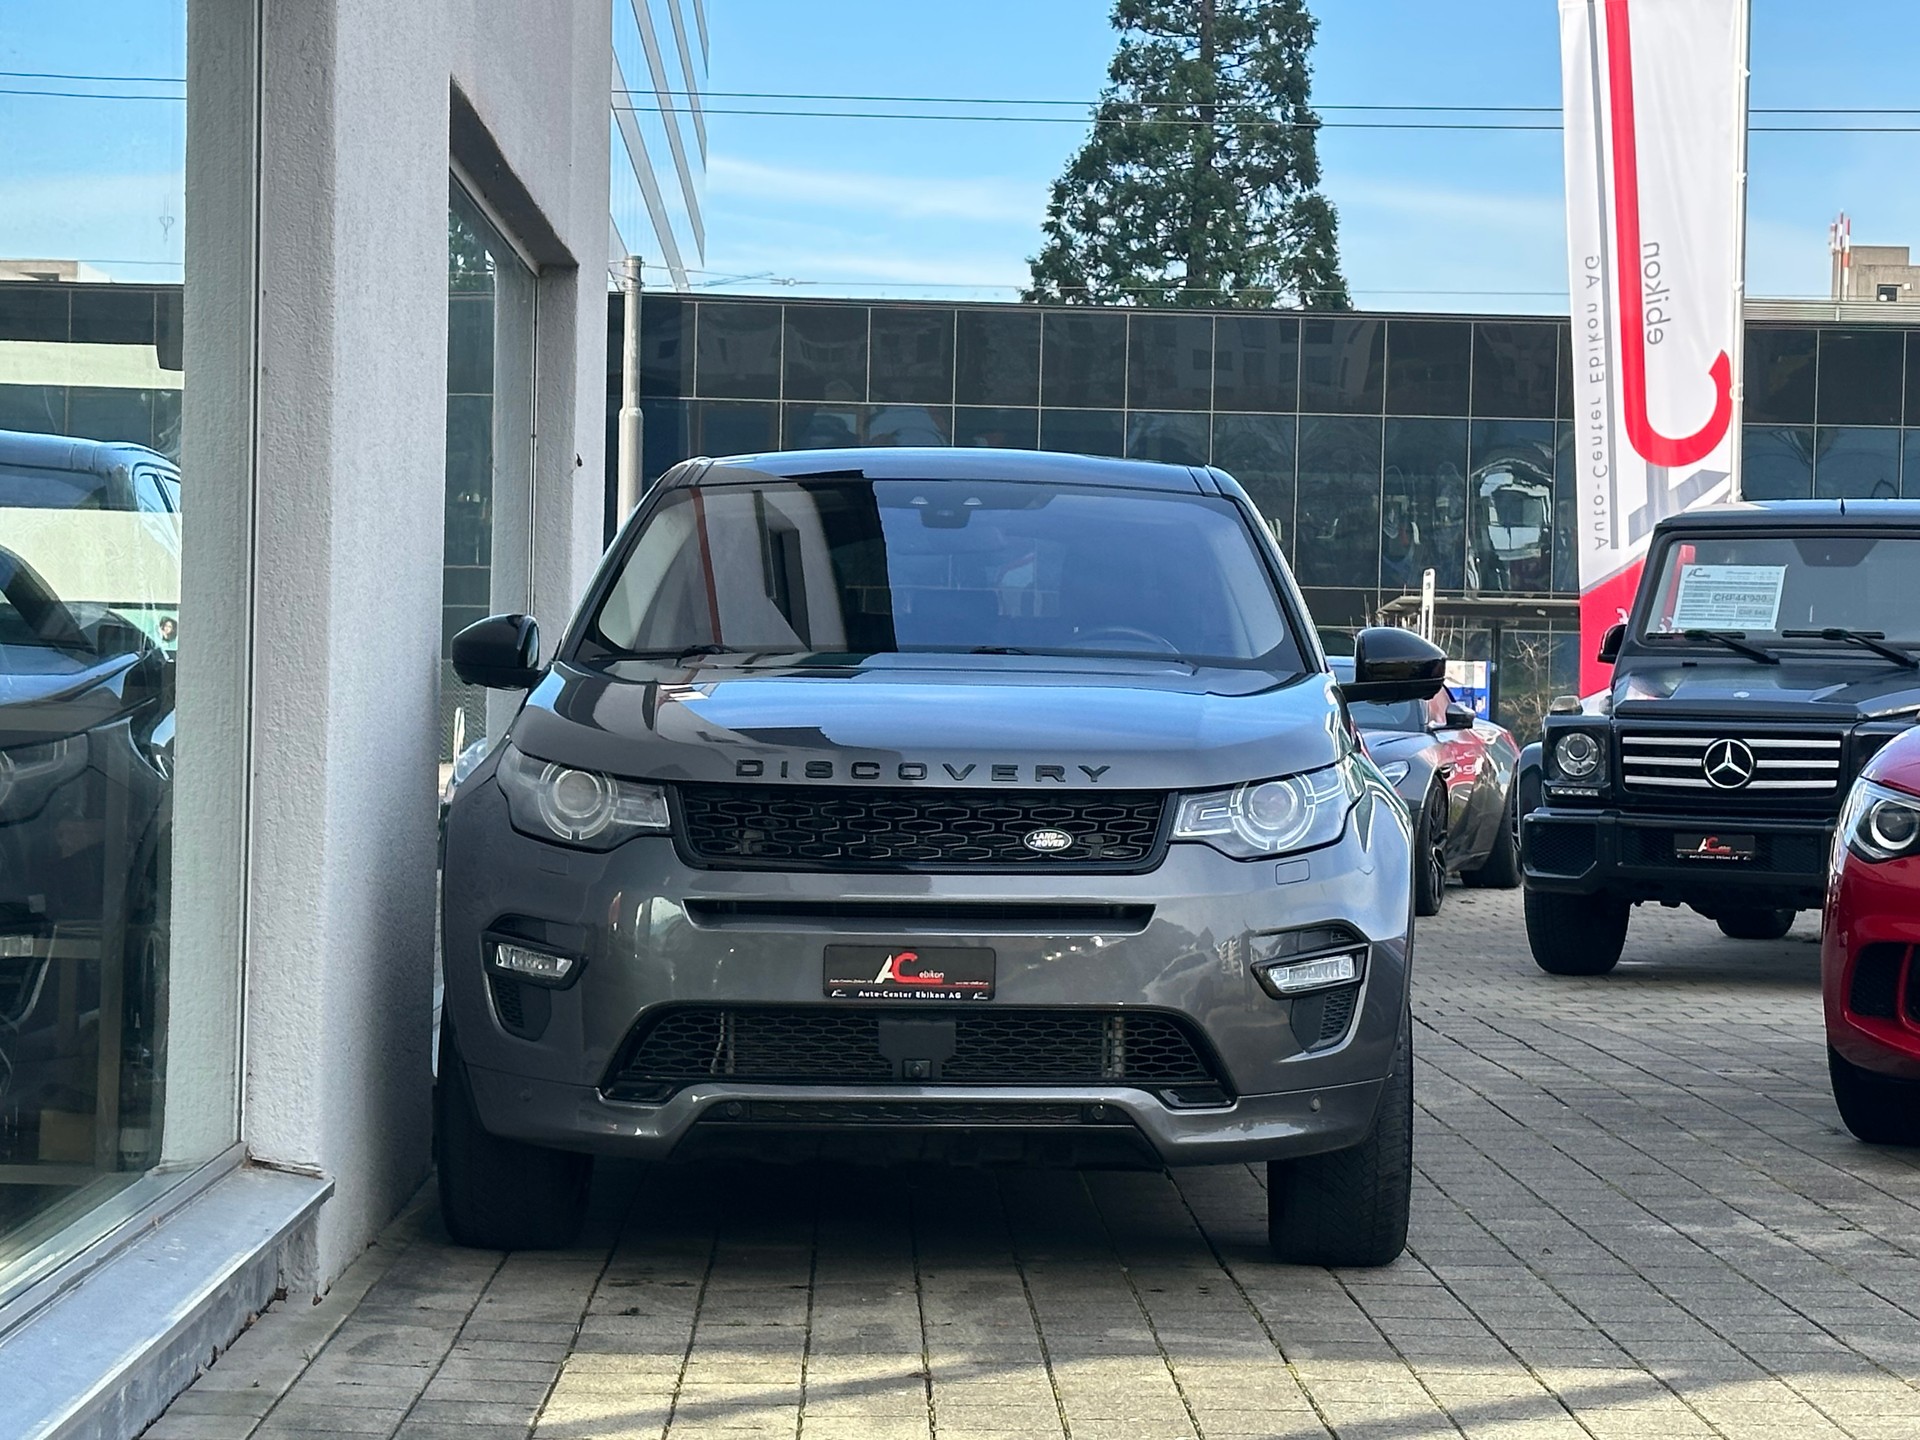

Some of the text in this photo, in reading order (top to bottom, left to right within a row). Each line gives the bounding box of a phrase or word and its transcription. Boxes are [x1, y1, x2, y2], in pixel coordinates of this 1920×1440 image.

[735, 758, 1111, 783] DISCOVERY
[919, 970, 945, 979] ebikon
[858, 990, 912, 998] Auto-Center
[949, 991, 962, 999] AG
